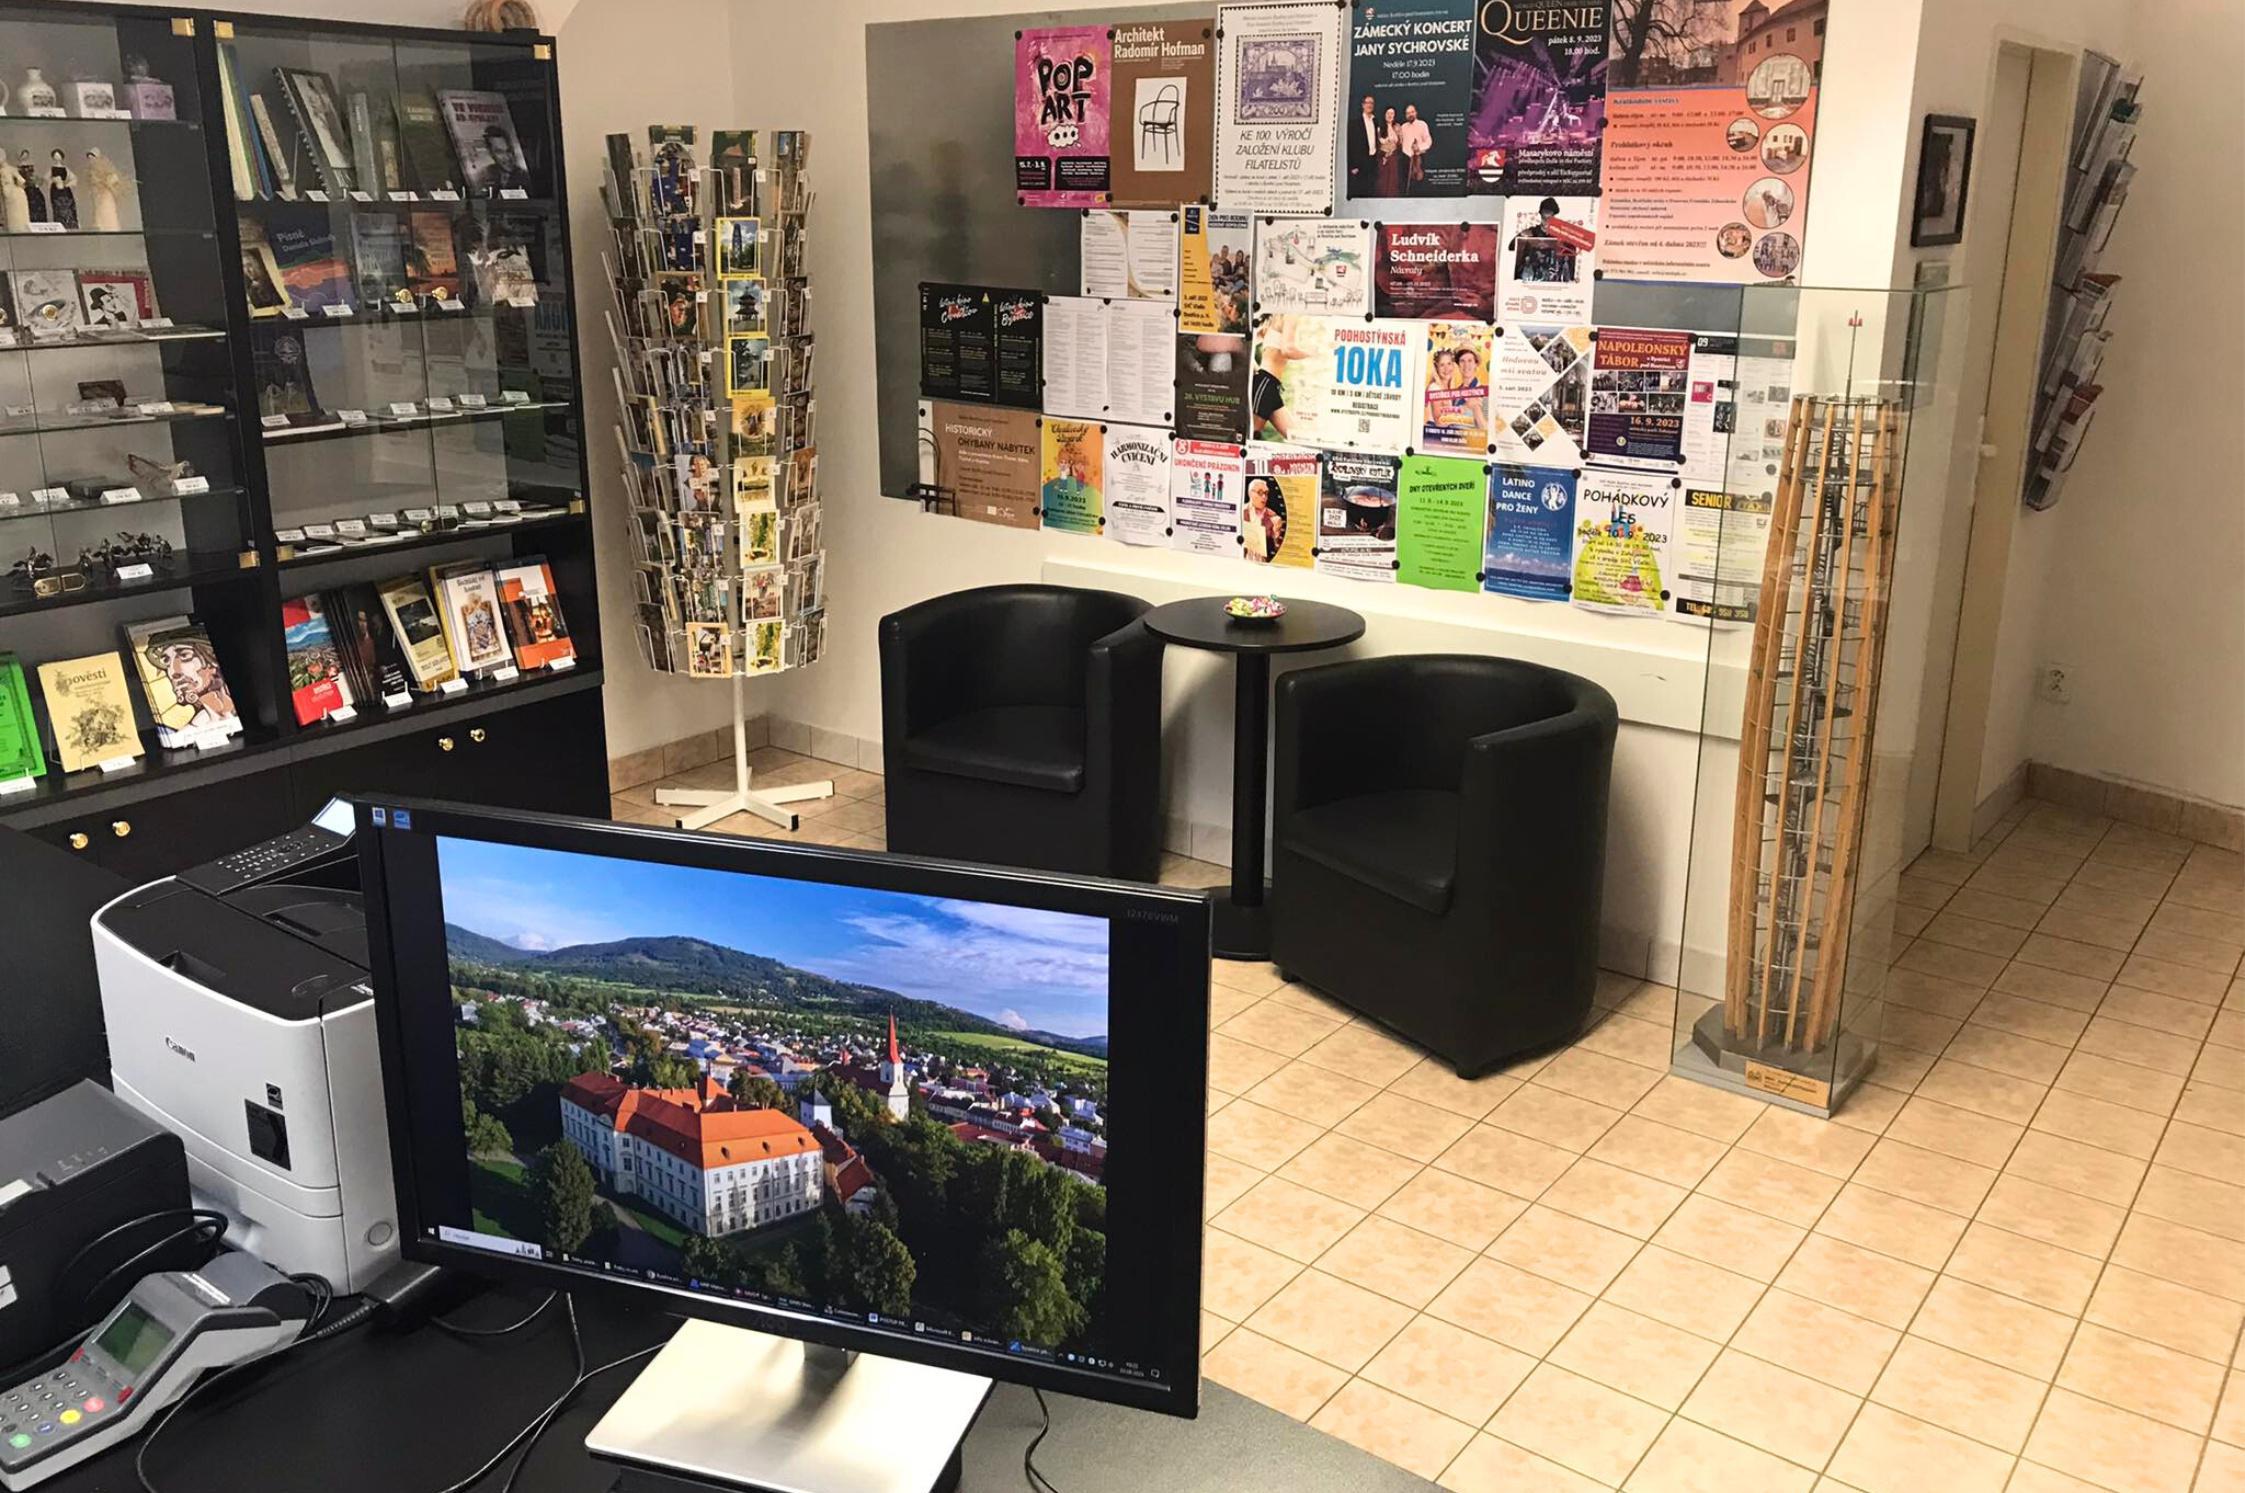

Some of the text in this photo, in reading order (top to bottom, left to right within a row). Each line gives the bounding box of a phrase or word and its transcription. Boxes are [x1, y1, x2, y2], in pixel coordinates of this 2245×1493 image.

[1354, 20, 1472, 39] ZÁMECKÝ KONCERT
[1481, 0, 1603, 45] QUEENIE
[1114, 27, 1165, 43] Architekt
[1548, 36, 1567, 46] pátek
[1585, 35, 1602, 43] 2023
[1161, 42, 1205, 56] Hofman
[1354, 36, 1470, 56] JANY SYCHROVSKÉ
[1037, 55, 1094, 98] POP
[1041, 91, 1091, 125] ART
[1240, 128, 1313, 141] KE 100 VÝROČÍ
[1235, 143, 1315, 156] ZALOŽENÍ KLUBU
[1245, 157, 1302, 170] FILATELISTŮ
[1392, 233, 1440, 246] Ludvík
[1390, 249, 1480, 263] Schneiderka
[1334, 328, 1407, 346] PODHOSTÝNSKÁ
[1598, 340, 1688, 356] NAPOLEONSKÝ
[1600, 354, 1640, 368] TÁBOR
[1656, 418, 1680, 428] 2023
[1121, 450, 1156, 466] CVIČENÍ
[1502, 477, 1536, 488] LATINO
[1502, 489, 1532, 501] DANCE
[1583, 489, 1669, 508] POHÁDKOVÝ
[1691, 492, 1733, 509] SENIOR
[1496, 502, 1539, 514] PRO ŽENY
[1611, 511, 1636, 524] LES
[1643, 532, 1667, 543] 2023
[165, 1036, 196, 1062] Canon
